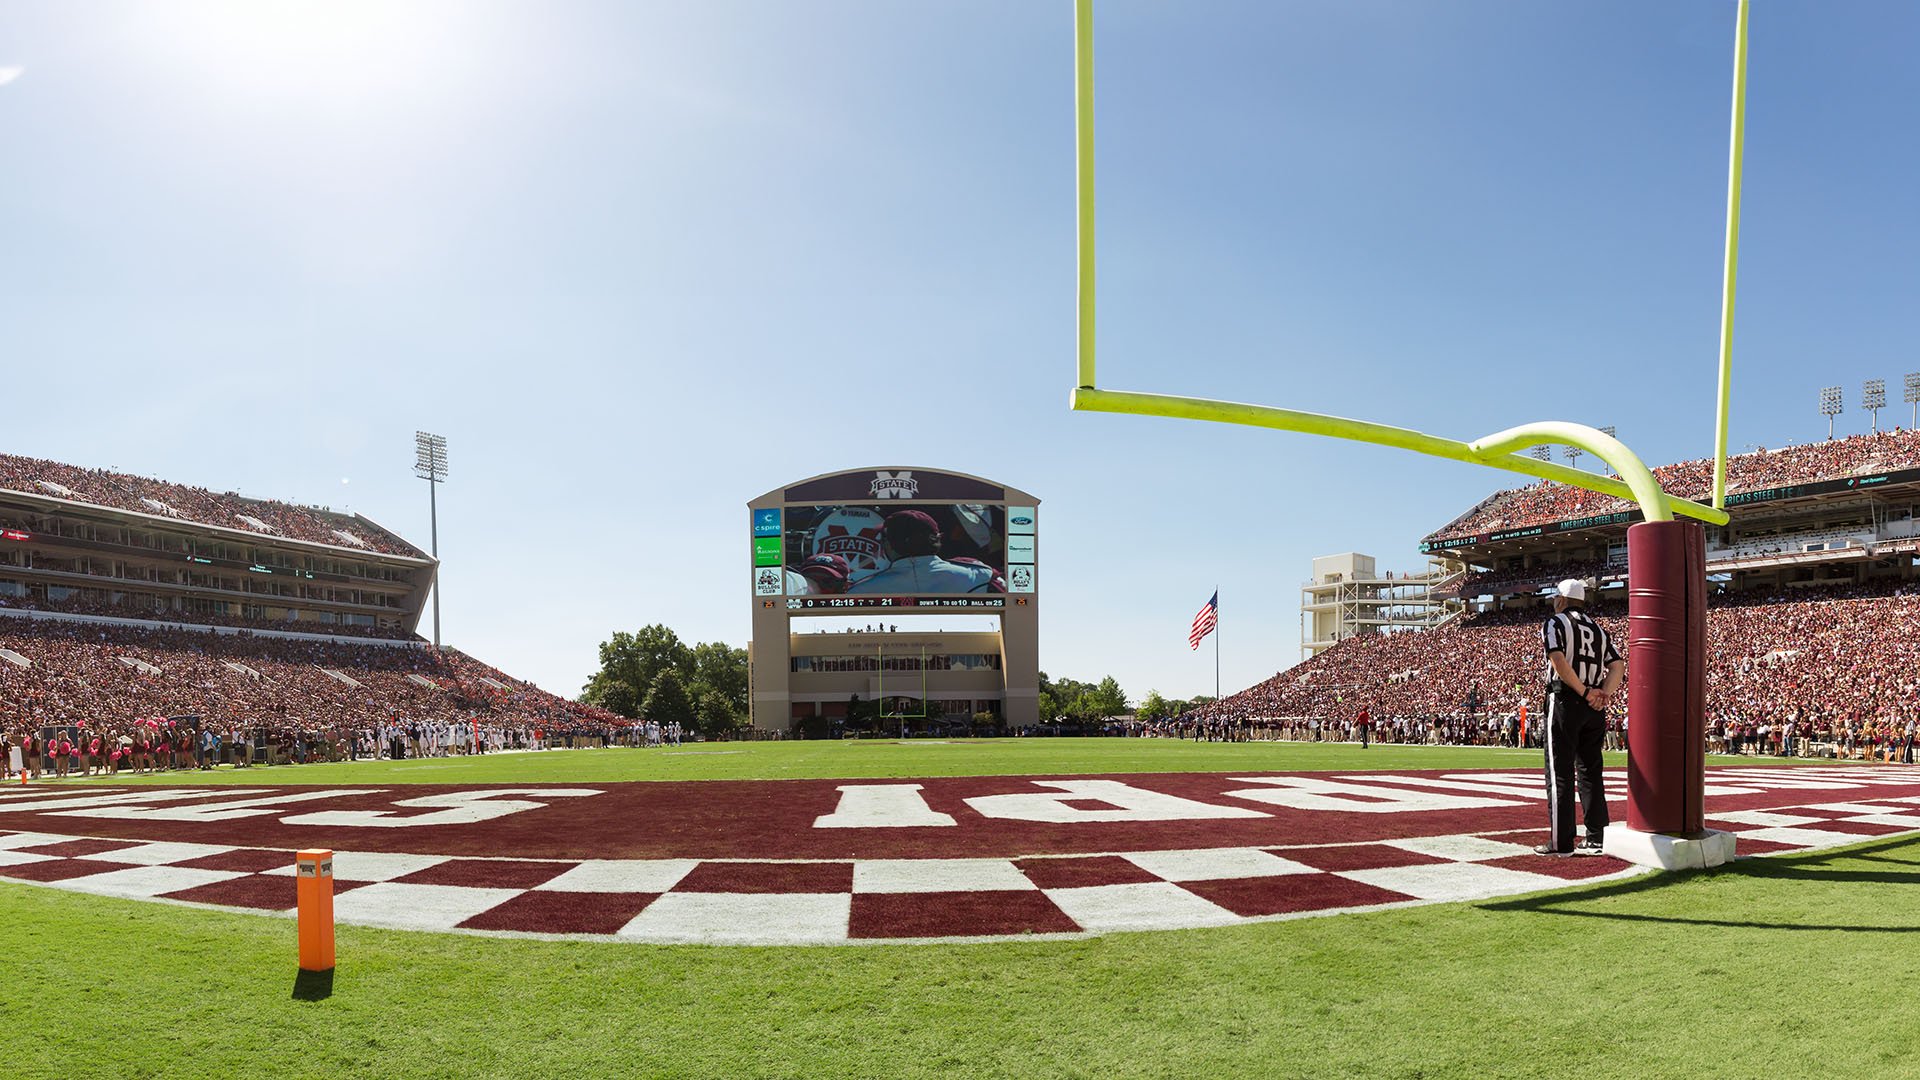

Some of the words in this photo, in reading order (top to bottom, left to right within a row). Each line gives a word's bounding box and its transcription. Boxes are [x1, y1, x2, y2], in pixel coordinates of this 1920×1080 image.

[880, 480, 909, 488] STATE
[1724, 493, 1751, 505] ERICA'S
[1753, 490, 1776, 501] STEEL
[1560, 517, 1593, 530] AMERICA'S
[1594, 515, 1611, 525] STEEL
[1613, 512, 1630, 522] TEAM
[830, 540, 874, 554] STATE
[830, 599, 854, 607] 12:15
[881, 598, 893, 606] 21
[1578, 624, 1596, 658] R
